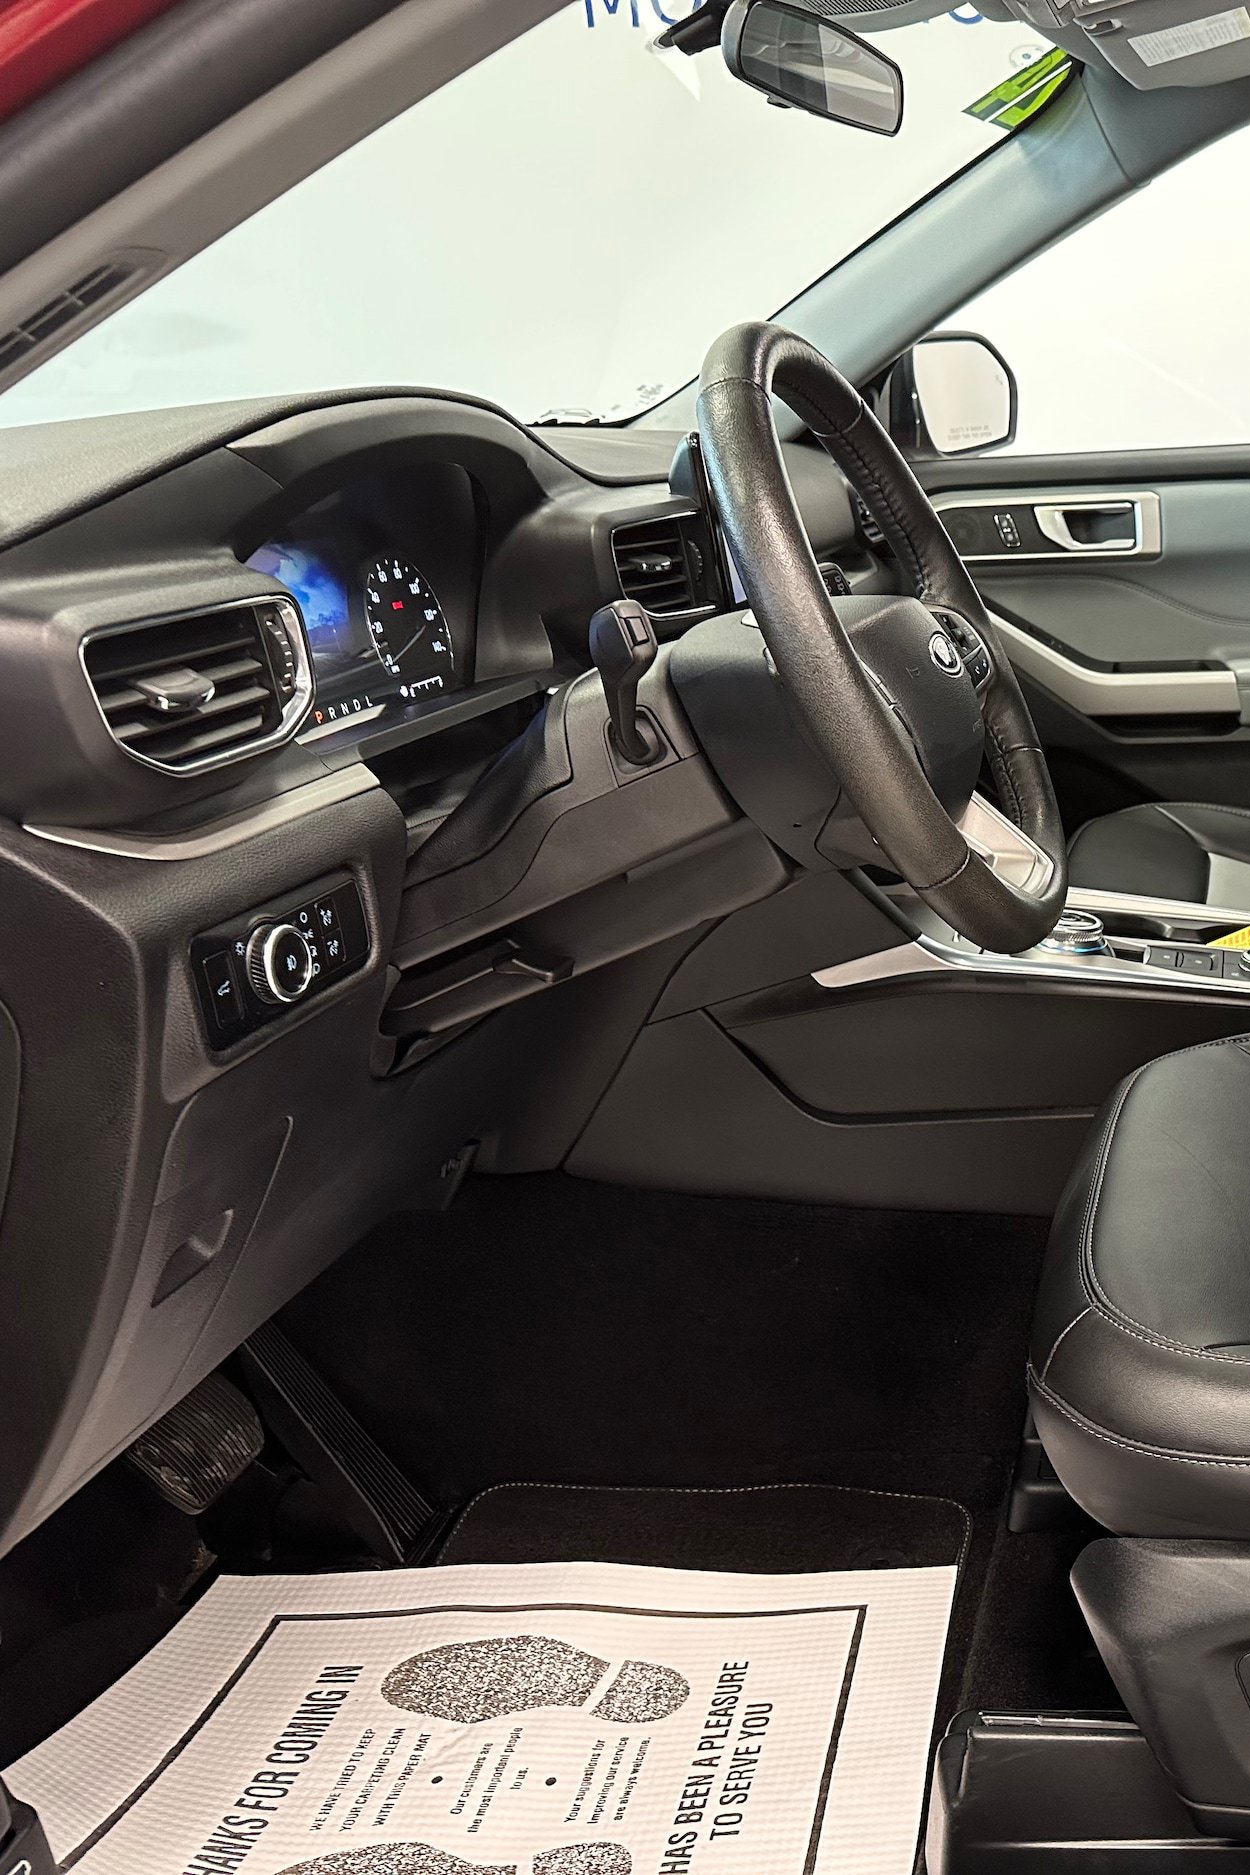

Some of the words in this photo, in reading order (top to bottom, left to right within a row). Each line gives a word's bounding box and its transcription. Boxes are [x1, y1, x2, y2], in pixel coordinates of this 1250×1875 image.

[315, 710, 323, 724] P
[328, 706, 337, 720] R
[340, 702, 350, 715] N
[353, 699, 361, 711] D
[364, 695, 373, 707] L
[315, 1665, 365, 1683] IN
[265, 1690, 350, 1764] COMING
[697, 1661, 749, 1751] PLEASURE
[737, 1703, 773, 1741] YOU
[611, 1737, 629, 1765] service
[691, 1755, 722, 1767] A
[233, 1771, 301, 1811] FOR
[309, 1817, 327, 1831] WE
[318, 1793, 341, 1815] HAVE
[332, 1764, 357, 1791] TRIED
[348, 1751, 364, 1763] TO
[356, 1728, 376, 1749] KEEP
[339, 1806, 363, 1832] YOUR
[355, 1758, 390, 1804] CARPETING
[382, 1728, 406, 1756] CLEAN
[371, 1803, 395, 1826] WITH
[386, 1782, 406, 1800] THIS
[397, 1754, 422, 1781] PAPER
[413, 1733, 432, 1752] MAT
[449, 1799, 466, 1815] Our
[460, 1757, 486, 1797] customers
[480, 1743, 494, 1754] are
[467, 1818, 482, 1833] the
[476, 1795, 493, 1816] most
[504, 1727, 523, 1752] people
[509, 1781, 523, 1790] to
[563, 1803, 581, 1823] Your
[575, 1753, 601, 1801] suggestions
[591, 1739, 606, 1751] for
[605, 1767, 618, 1781] our
[619, 1776, 638, 1804] always
[719, 1745, 762, 1806] SERVE
[613, 1806, 626, 1821] are
[674, 1774, 715, 1825] BEEN
[709, 1812, 743, 1840] TO
[658, 1831, 698, 1875] HAS
